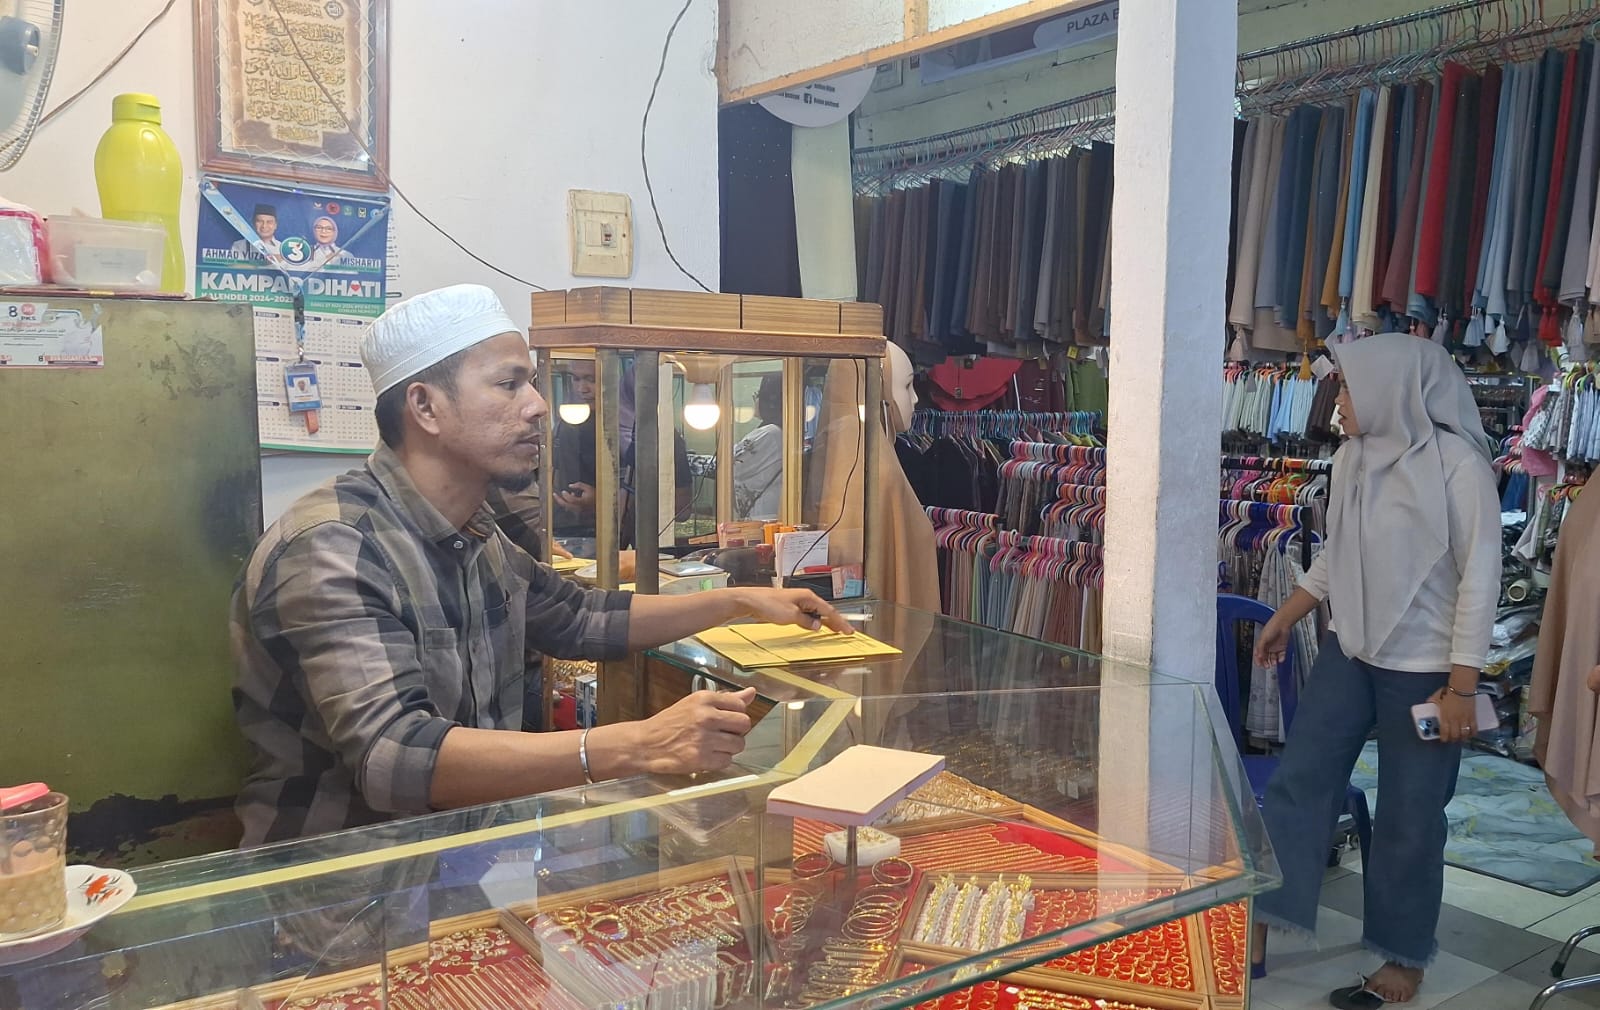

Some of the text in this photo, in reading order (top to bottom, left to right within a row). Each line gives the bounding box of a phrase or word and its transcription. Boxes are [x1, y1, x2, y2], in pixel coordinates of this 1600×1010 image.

[1067, 11, 1109, 33] PLAZA
[205, 249, 239, 260] AHMAD
[242, 250, 266, 261] YUZA
[287, 241, 304, 261] 3
[340, 257, 381, 269] MISHARTI
[308, 278, 381, 298] DIHATI
[9, 305, 18, 318] 8
